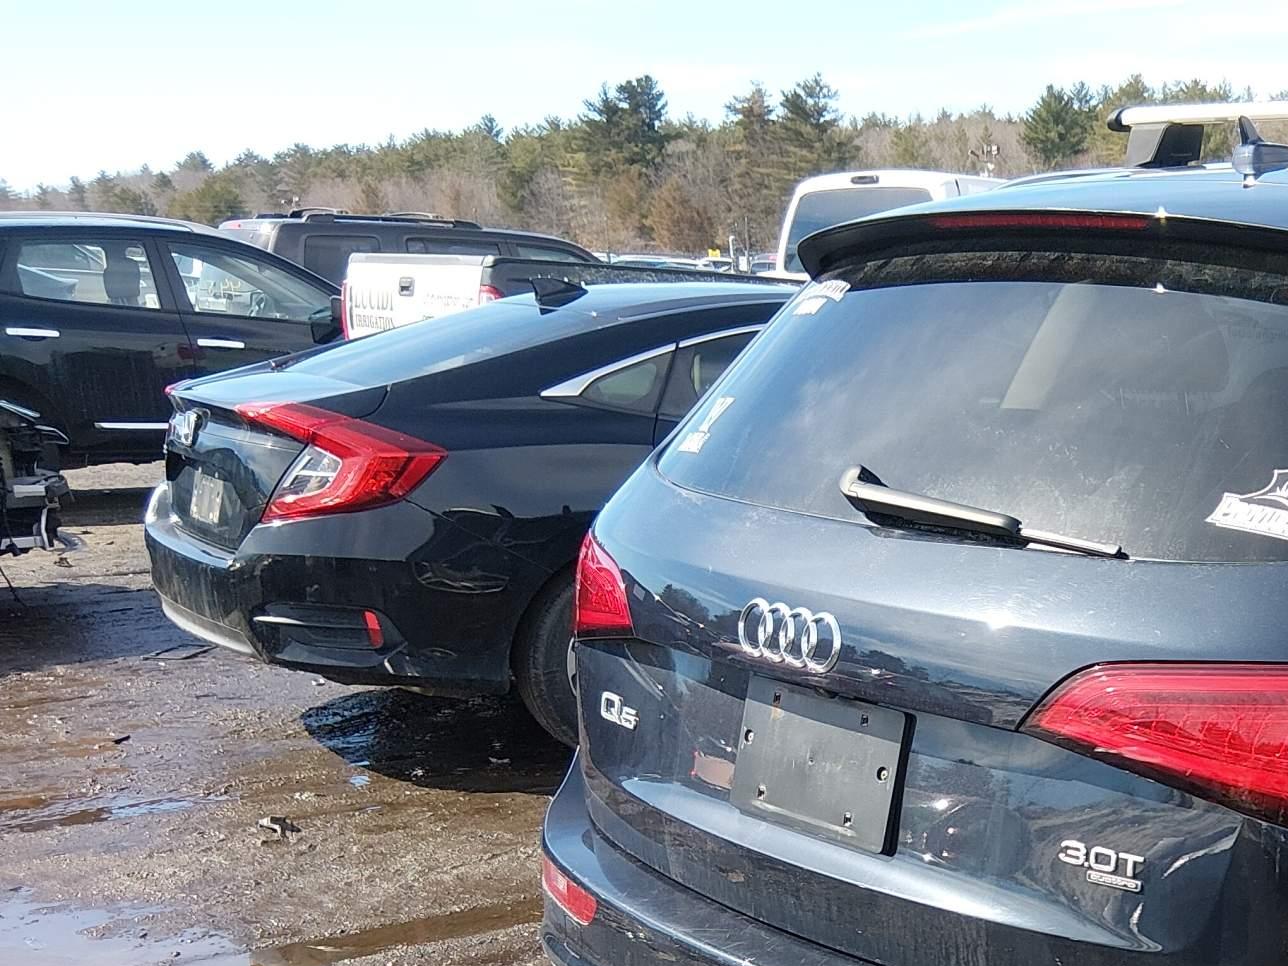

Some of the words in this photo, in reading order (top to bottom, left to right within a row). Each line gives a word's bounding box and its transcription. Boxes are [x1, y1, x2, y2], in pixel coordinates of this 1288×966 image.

[354, 287, 394, 312] LUCIDI
[600, 691, 640, 731] Q5
[1058, 839, 1145, 878] 3.0T
